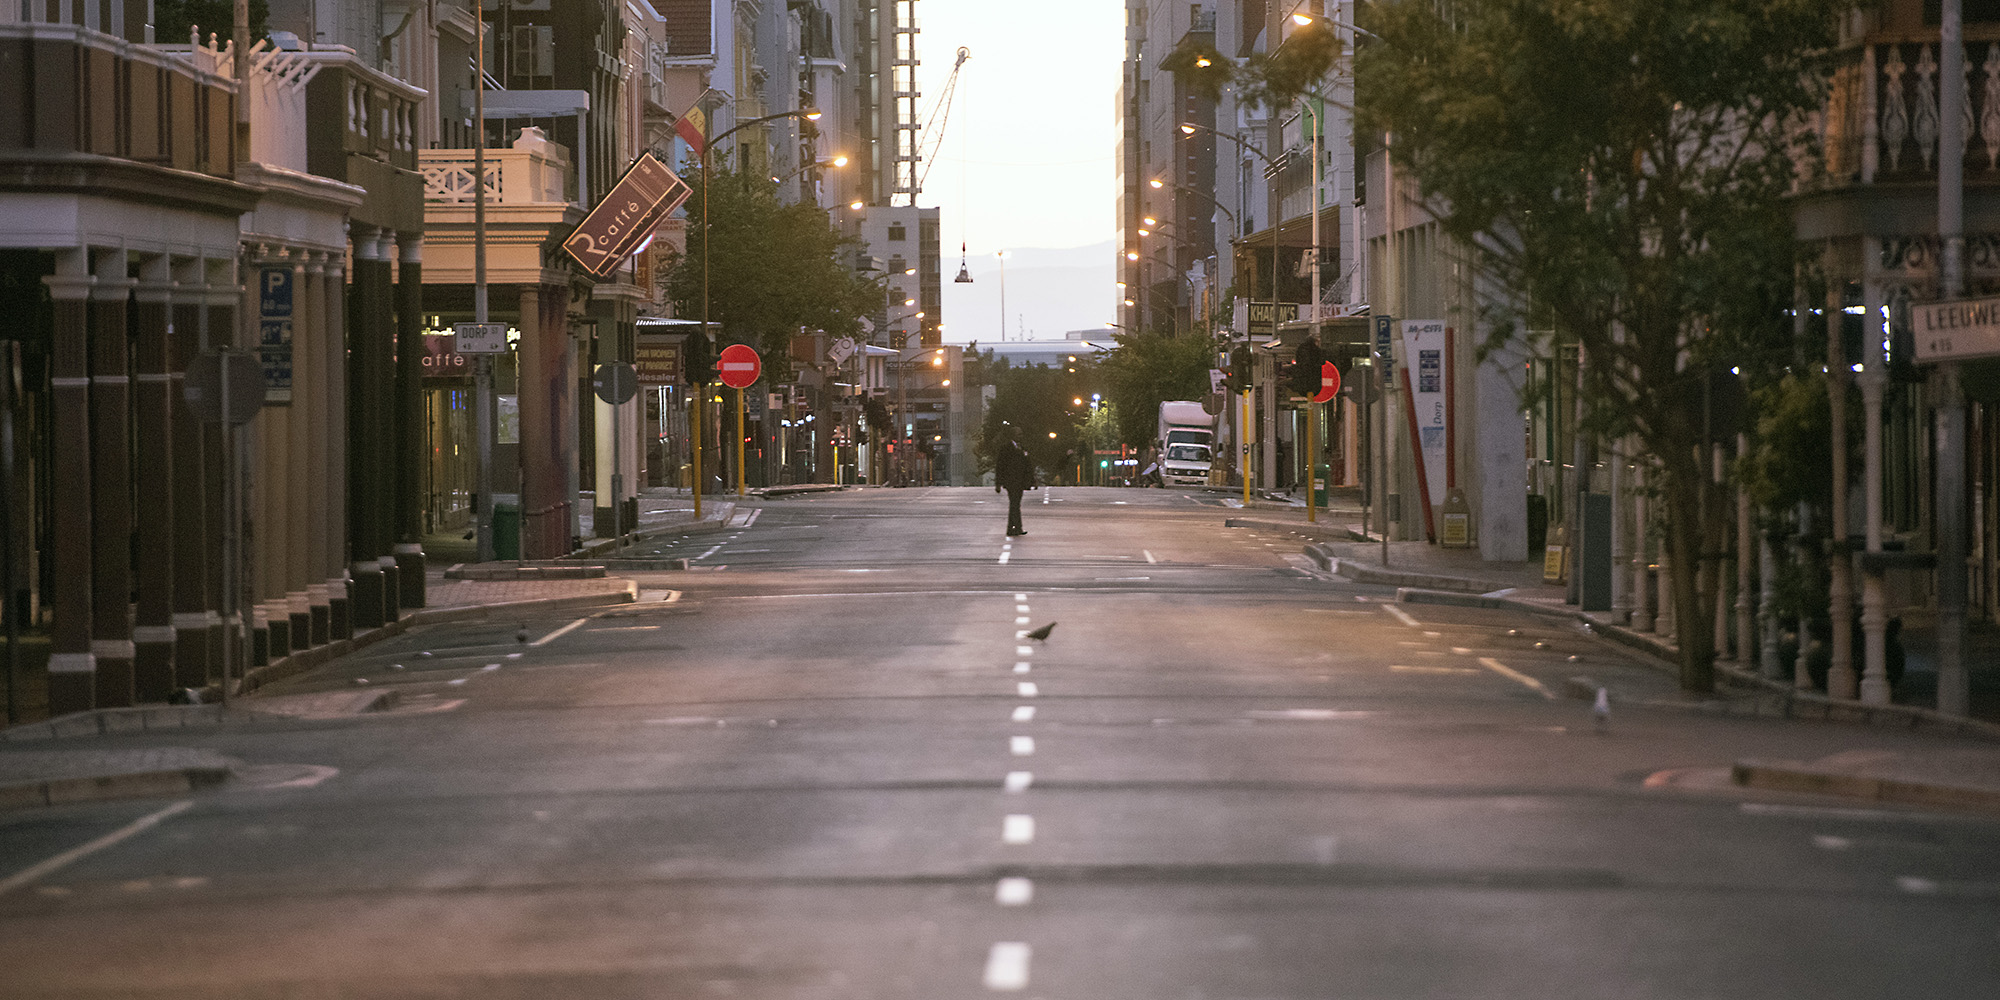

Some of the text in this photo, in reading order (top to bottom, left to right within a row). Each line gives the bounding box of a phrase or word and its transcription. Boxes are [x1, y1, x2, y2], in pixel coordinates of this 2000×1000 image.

[268, 272, 285, 294] P
[1250, 304, 1296, 322] KHADM'S
[462, 326, 488, 339] DORP
[491, 326, 499, 335] ST
[1433, 401, 1444, 425] Dorp
